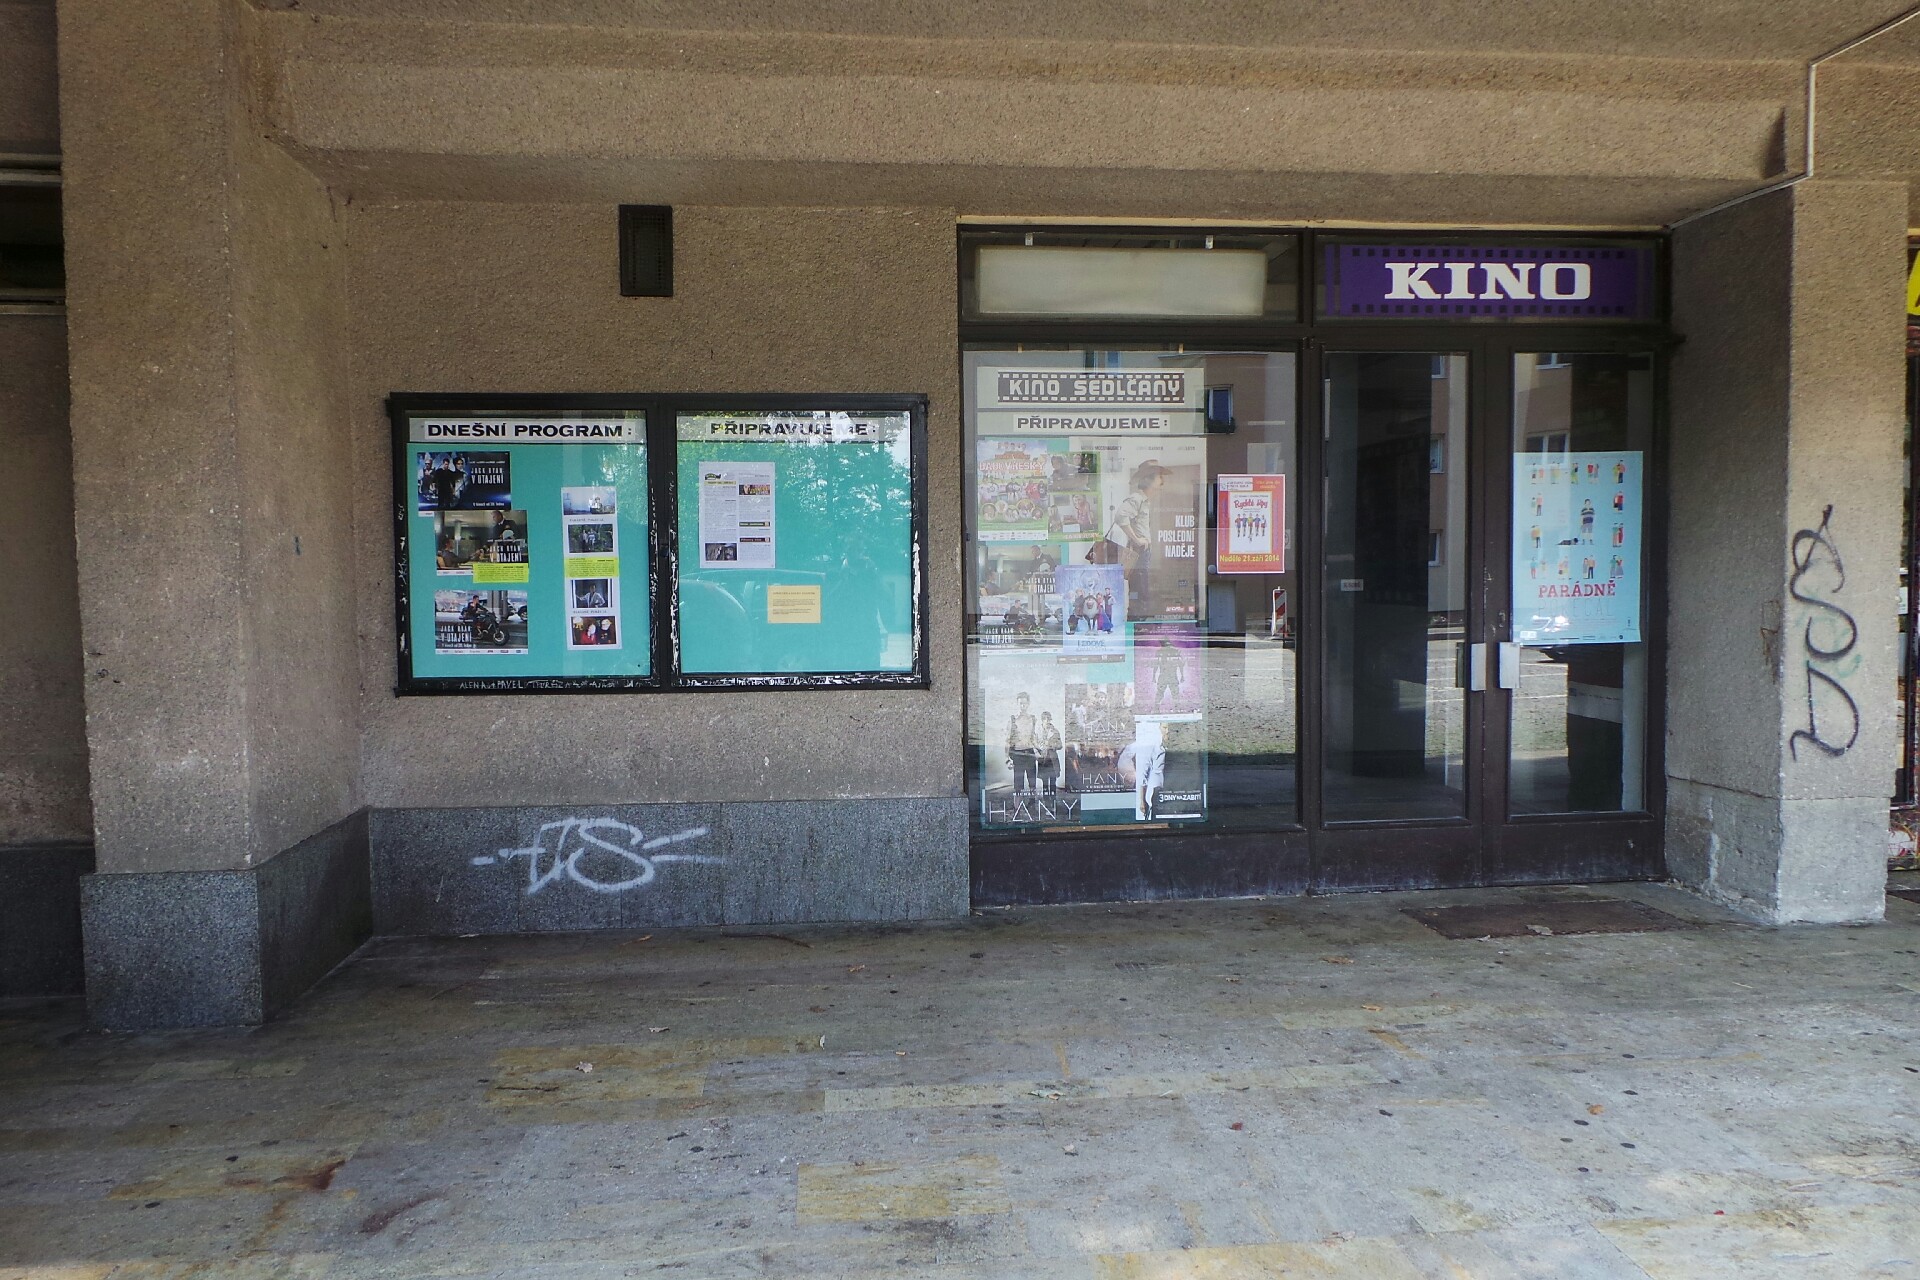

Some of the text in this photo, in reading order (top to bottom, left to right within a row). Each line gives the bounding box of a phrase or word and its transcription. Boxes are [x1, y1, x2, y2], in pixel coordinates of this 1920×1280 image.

[1384, 262, 1591, 300] KINO
[1009, 376, 1180, 397] KINO SEDLČANY
[427, 422, 506, 437] DNEŠNÍ
[1017, 415, 1168, 429] PŘIPRAVUJEME:
[1175, 515, 1195, 528] KLUB
[1158, 528, 1195, 542] POSLEDNÍ
[1165, 543, 1195, 558] NADĚJE
[1219, 554, 1242, 562] Neděle
[1265, 554, 1280, 562] 2014
[1538, 580, 1616, 598] PARÁDNĚ
[1082, 773, 1128, 784] HANY
[988, 799, 1078, 822] HANY
